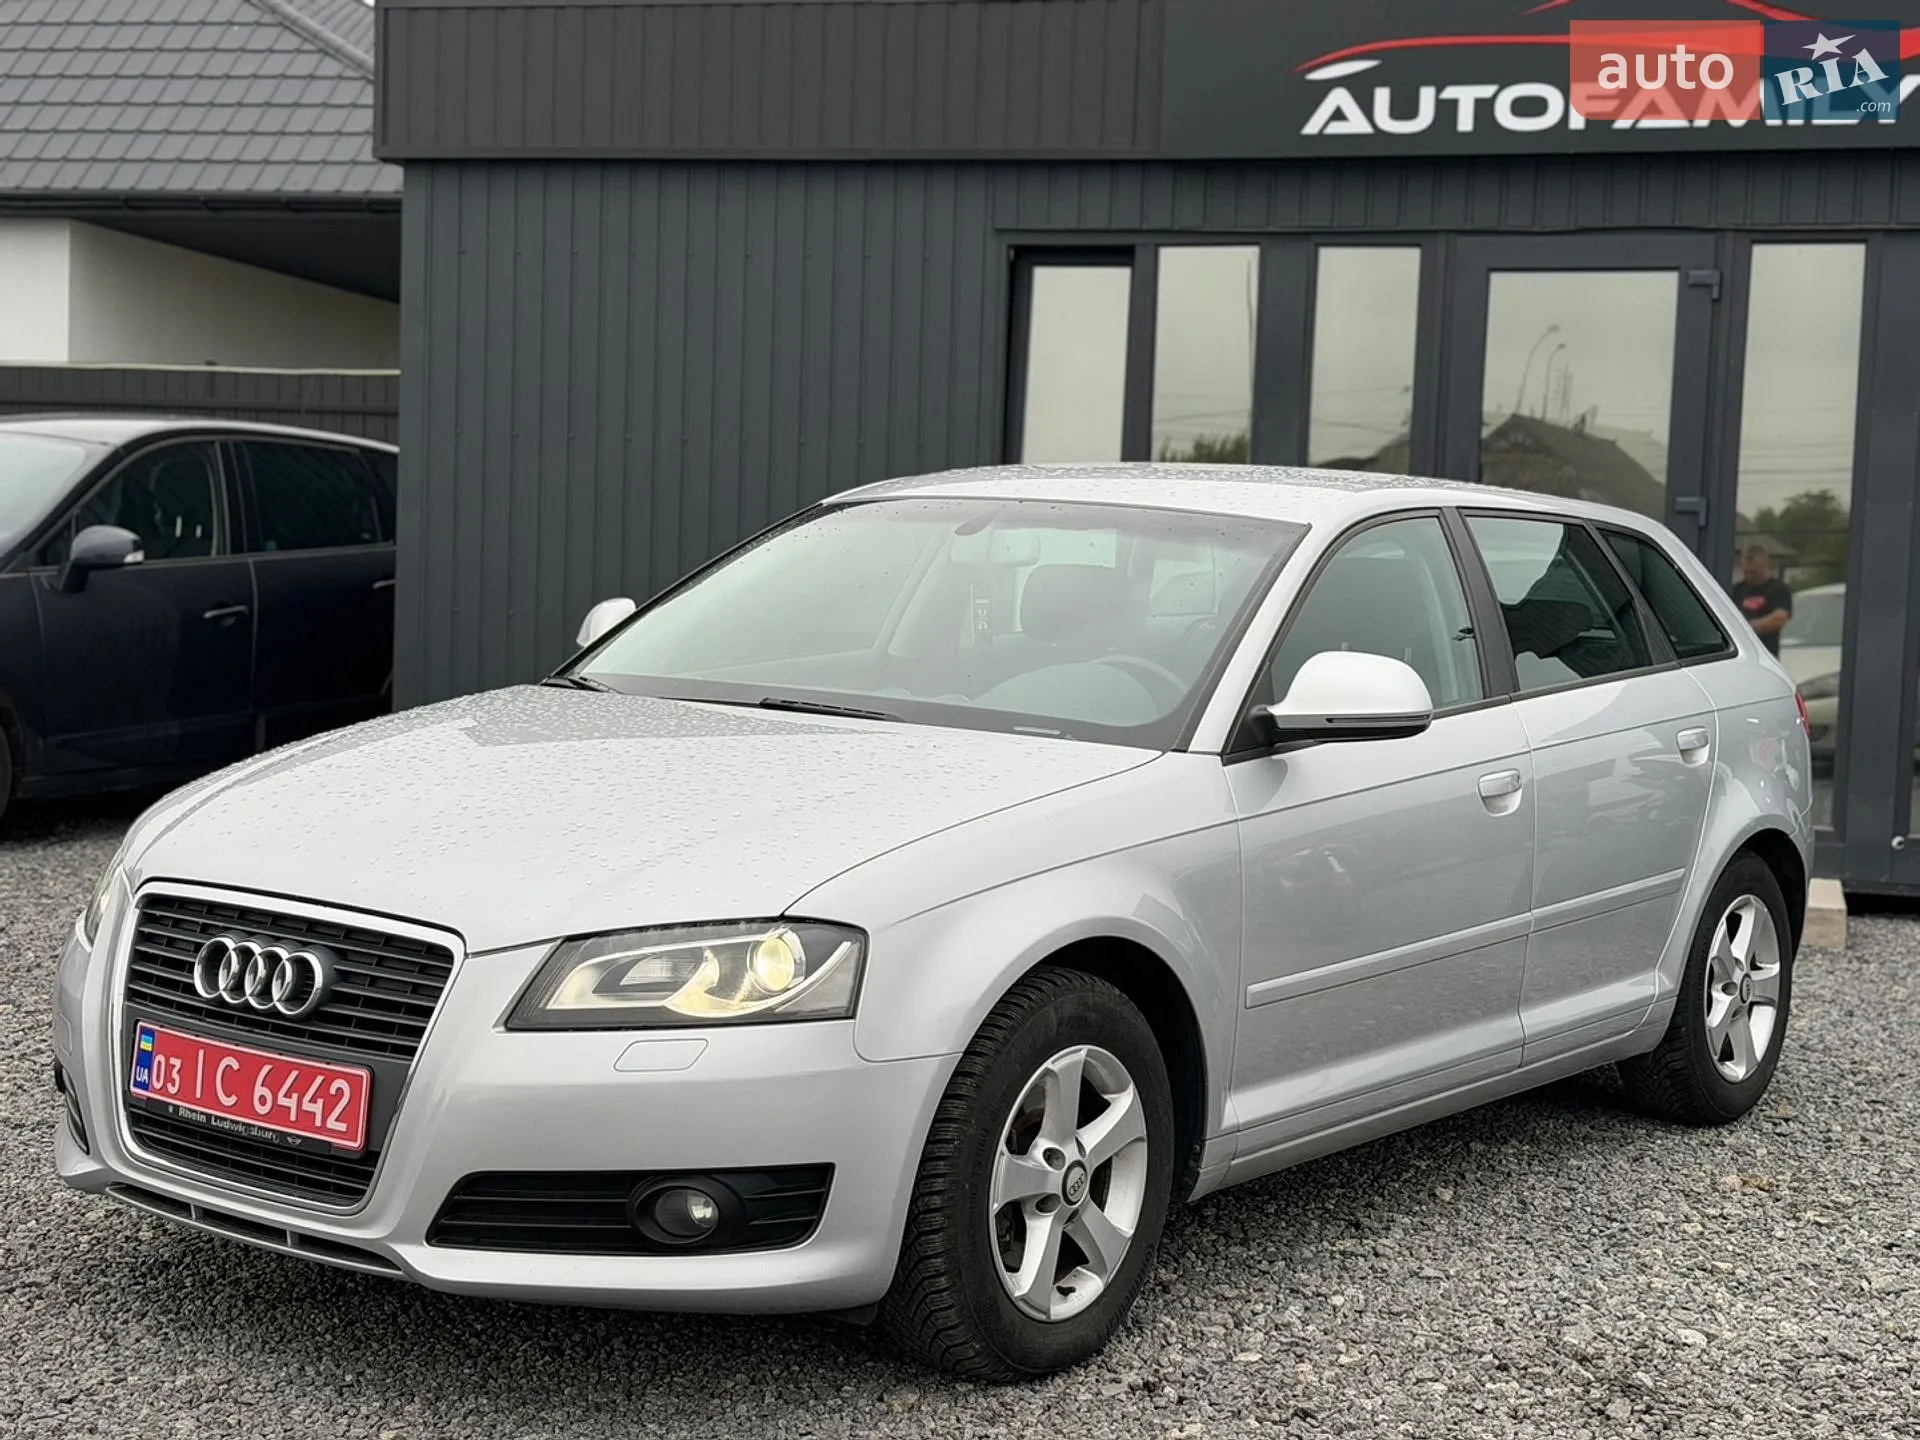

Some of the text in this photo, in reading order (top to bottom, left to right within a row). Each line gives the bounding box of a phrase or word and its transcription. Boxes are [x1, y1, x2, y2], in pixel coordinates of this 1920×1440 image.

[136, 1066, 149, 1084] UA
[152, 1054, 183, 1095] 03
[253, 1064, 351, 1132] 6442
[178, 1107, 207, 1124] Rhein
